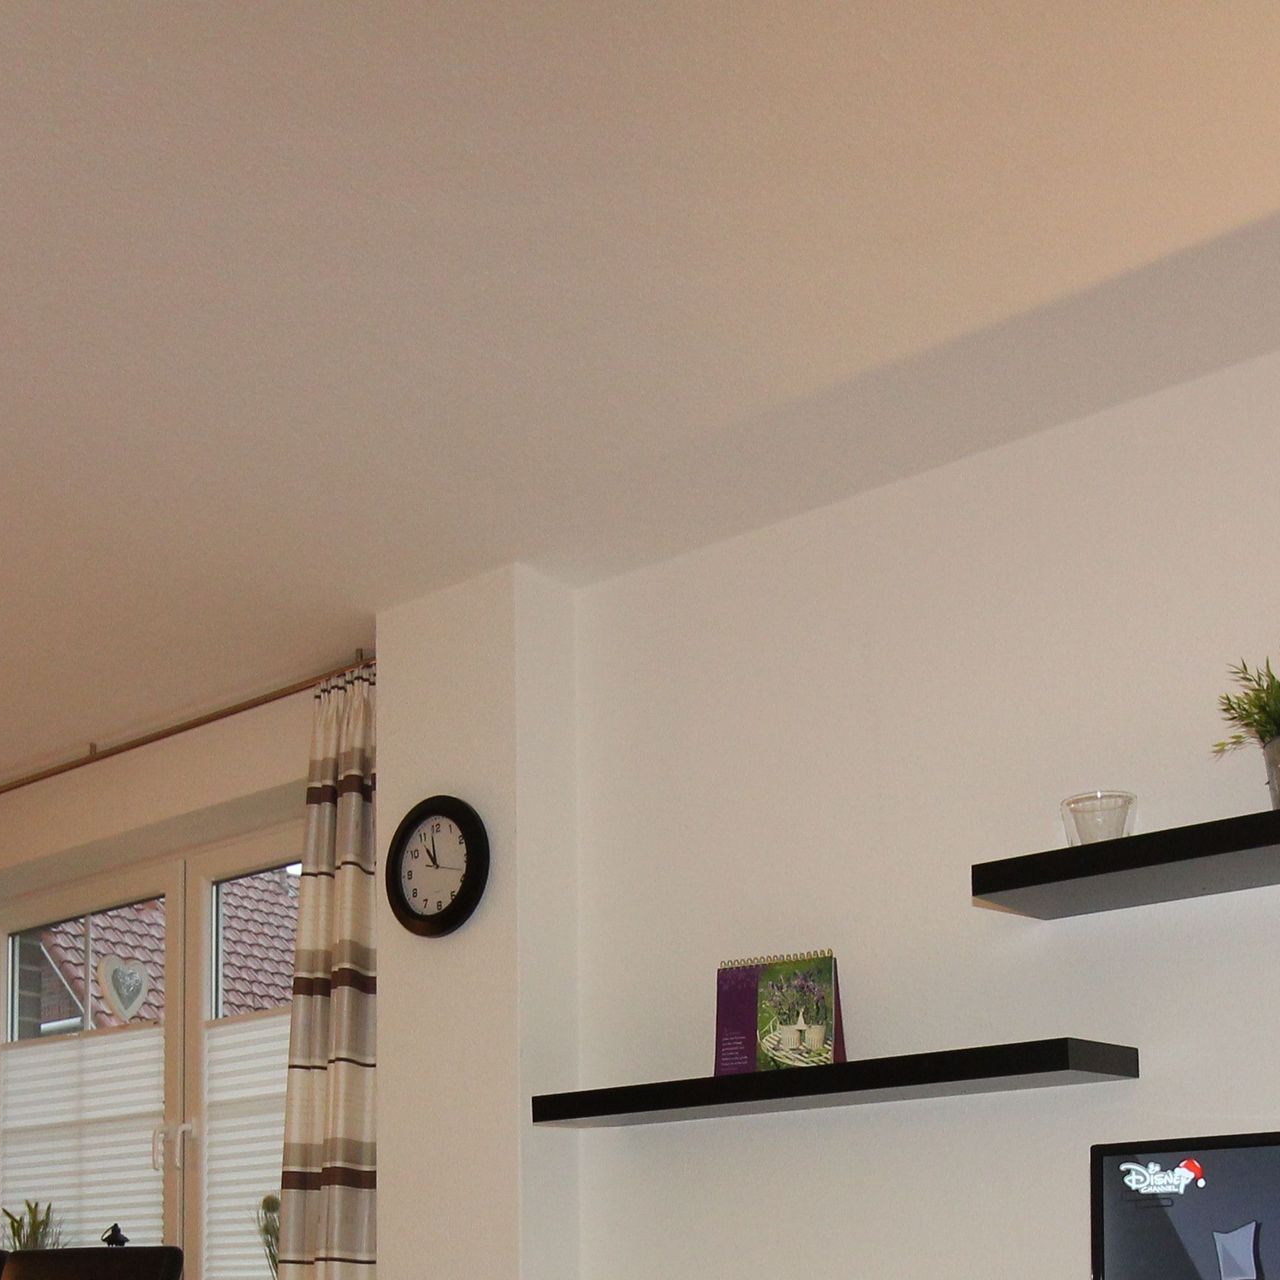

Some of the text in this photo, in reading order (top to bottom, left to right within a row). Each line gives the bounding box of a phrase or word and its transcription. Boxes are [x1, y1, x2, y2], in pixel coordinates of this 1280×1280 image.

[431, 823, 441, 834] 12
[419, 832, 427, 843] 11
[410, 849, 420, 859] 10
[407, 870, 413, 880] 9
[412, 887, 418, 898] 8
[423, 898, 429, 909] 7
[436, 900, 442, 911] 6
